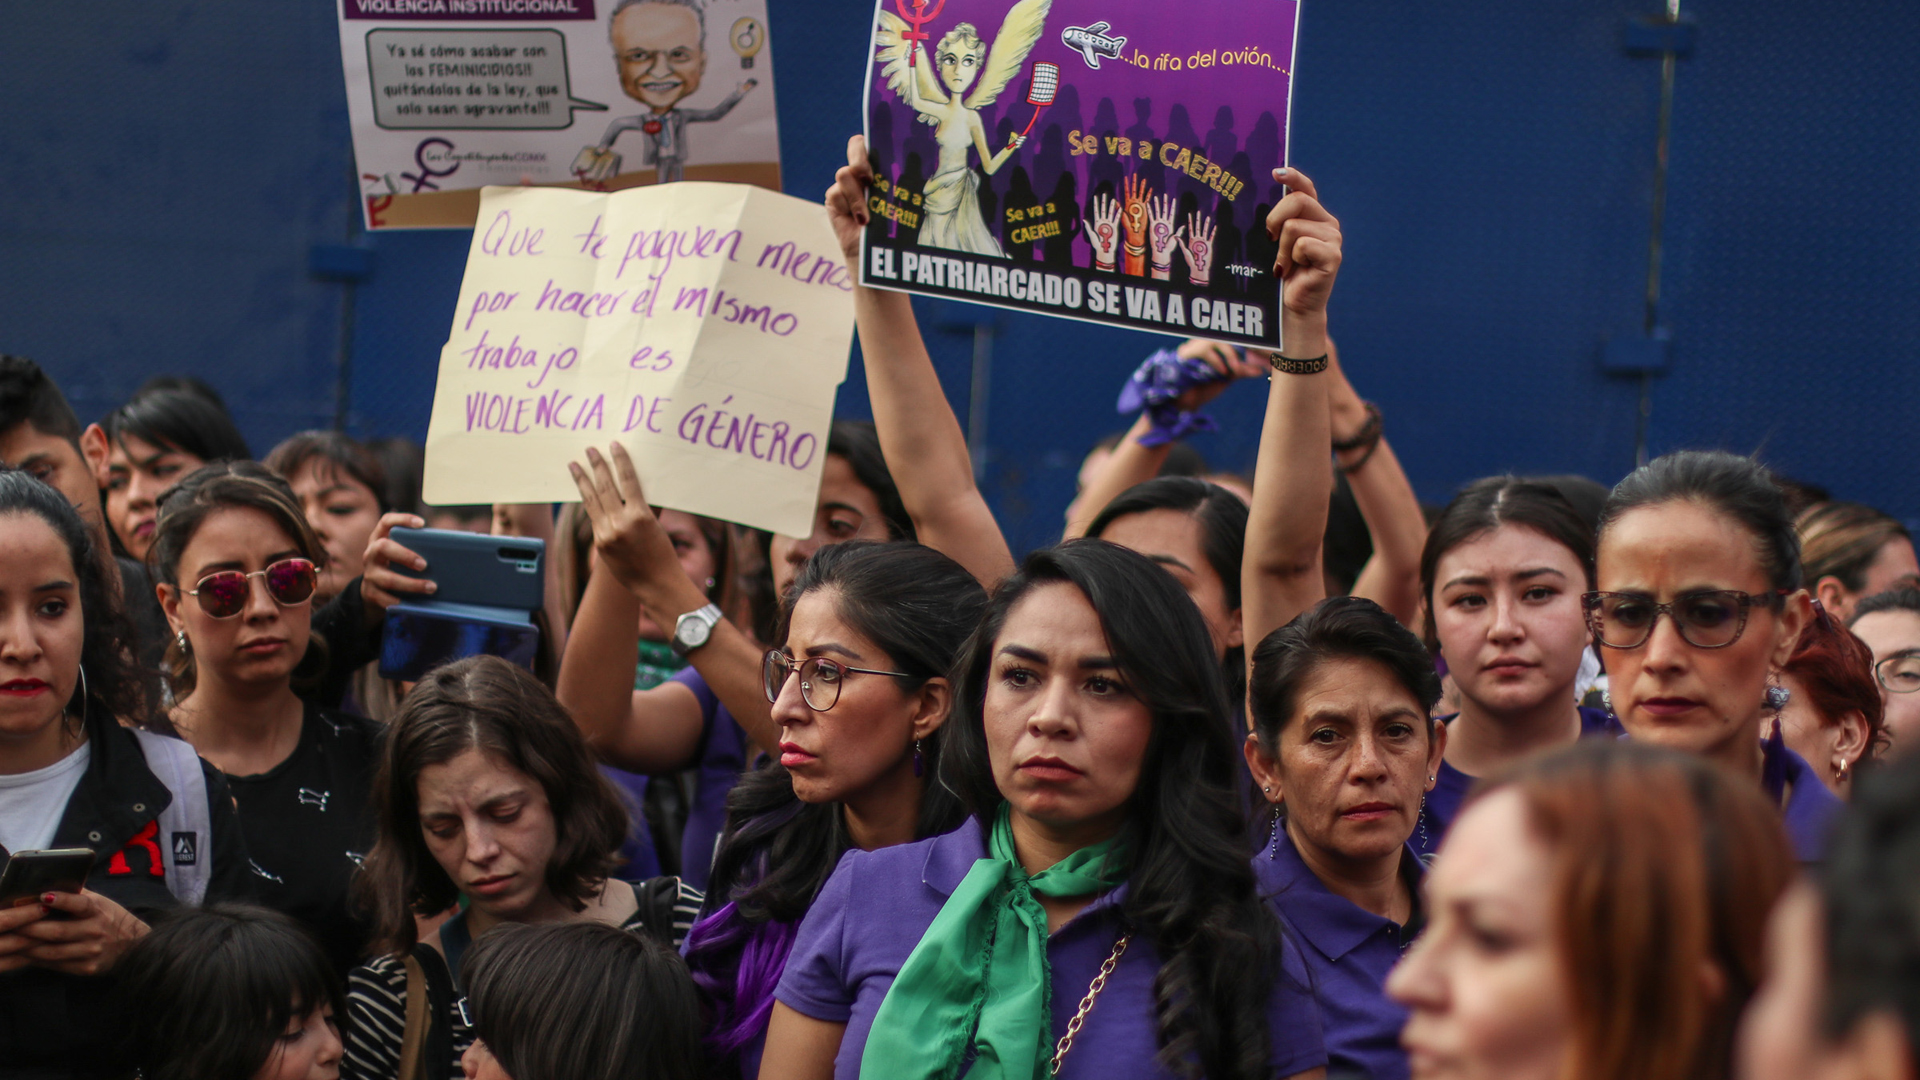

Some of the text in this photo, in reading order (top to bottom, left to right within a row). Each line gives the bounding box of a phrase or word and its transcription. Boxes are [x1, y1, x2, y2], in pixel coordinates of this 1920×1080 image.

[357, 0, 579, 14] VIOLENCIA INSTITUCIONAL
[386, 43, 406, 57] Ya
[430, 44, 465, 57] cómo
[470, 43, 517, 57] acabar
[522, 46, 547, 57] con
[1153, 53, 1182, 71] rifa
[1187, 49, 1217, 69] del
[466, 82, 482, 96] de
[486, 83, 500, 96] la
[535, 84, 559, 98] que
[427, 104, 457, 115] sean
[1067, 129, 1244, 202] Se va a CAER!!!
[873, 173, 922, 206] Se va a
[869, 195, 918, 228] CAER!!!
[1006, 202, 1056, 223] Se va a
[482, 209, 545, 256] Que
[573, 214, 609, 259] te
[615, 225, 743, 282] paguen
[1010, 220, 1062, 244] CAER!!!
[1225, 263, 1263, 278] -mar-
[464, 273, 798, 336] por hacer el mismo
[871, 246, 1264, 337] EL PATRIARCADO SE VA A CAER
[460, 330, 674, 389] trabajo es
[466, 389, 817, 471] VIOLENCIA DE GÉNERO
